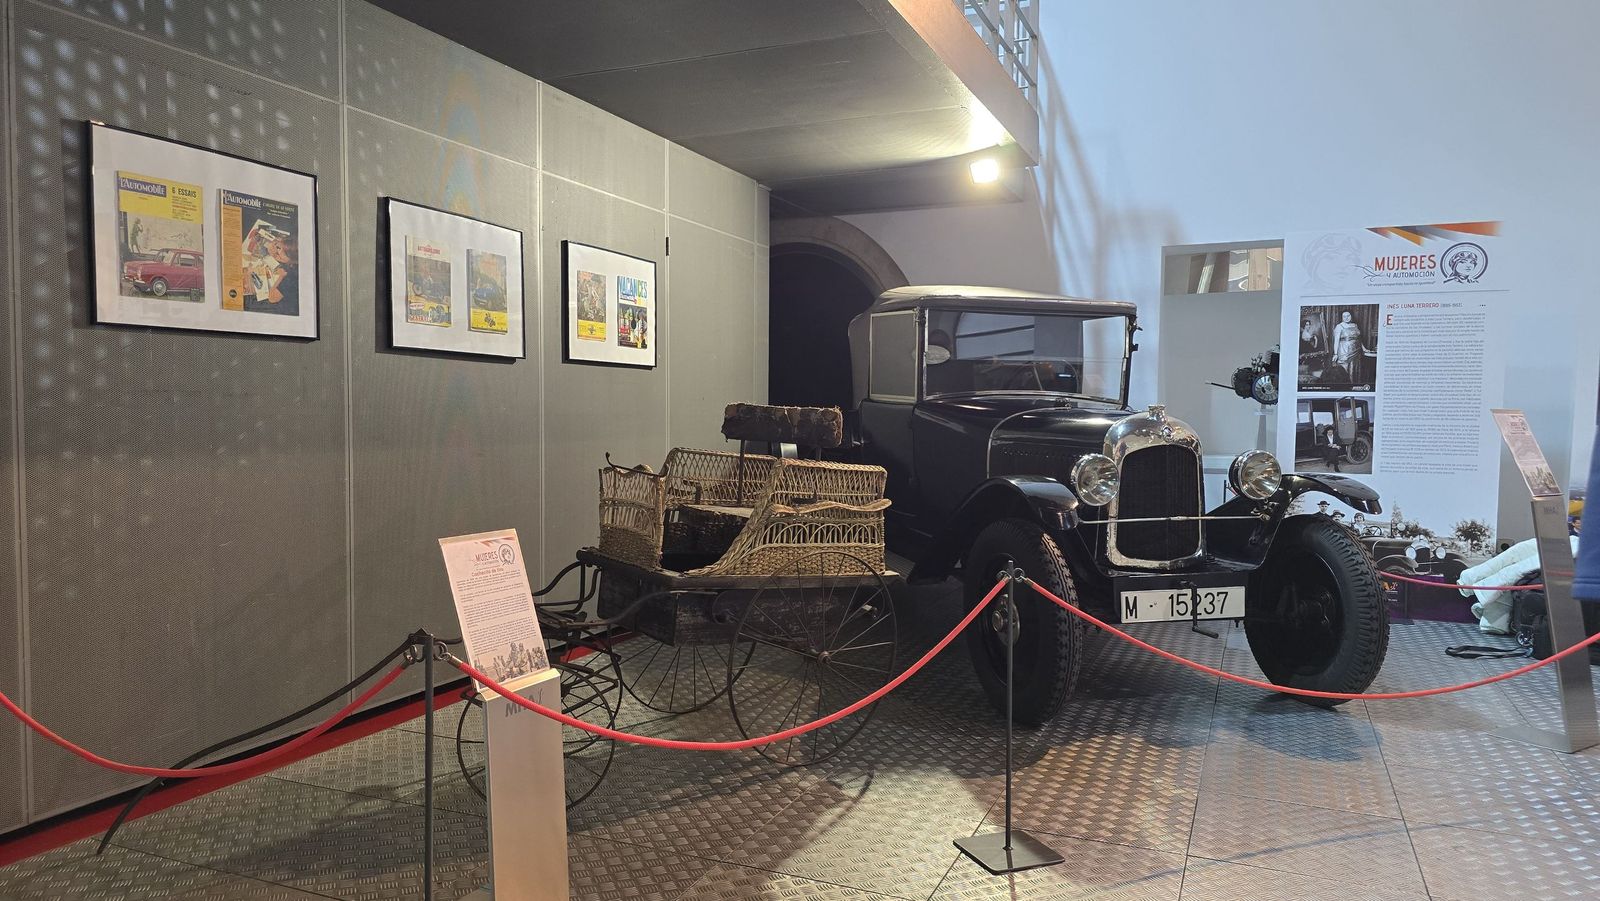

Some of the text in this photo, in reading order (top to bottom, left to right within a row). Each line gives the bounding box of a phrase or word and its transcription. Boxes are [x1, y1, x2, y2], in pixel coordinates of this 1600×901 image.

[177, 187, 197, 198] ESSAIS
[1374, 254, 1437, 272] MUJERES
[1392, 270, 1436, 279] AUTOMOCIÓN
[475, 550, 499, 562] MUJERES
[1124, 591, 1229, 620] M 15237
